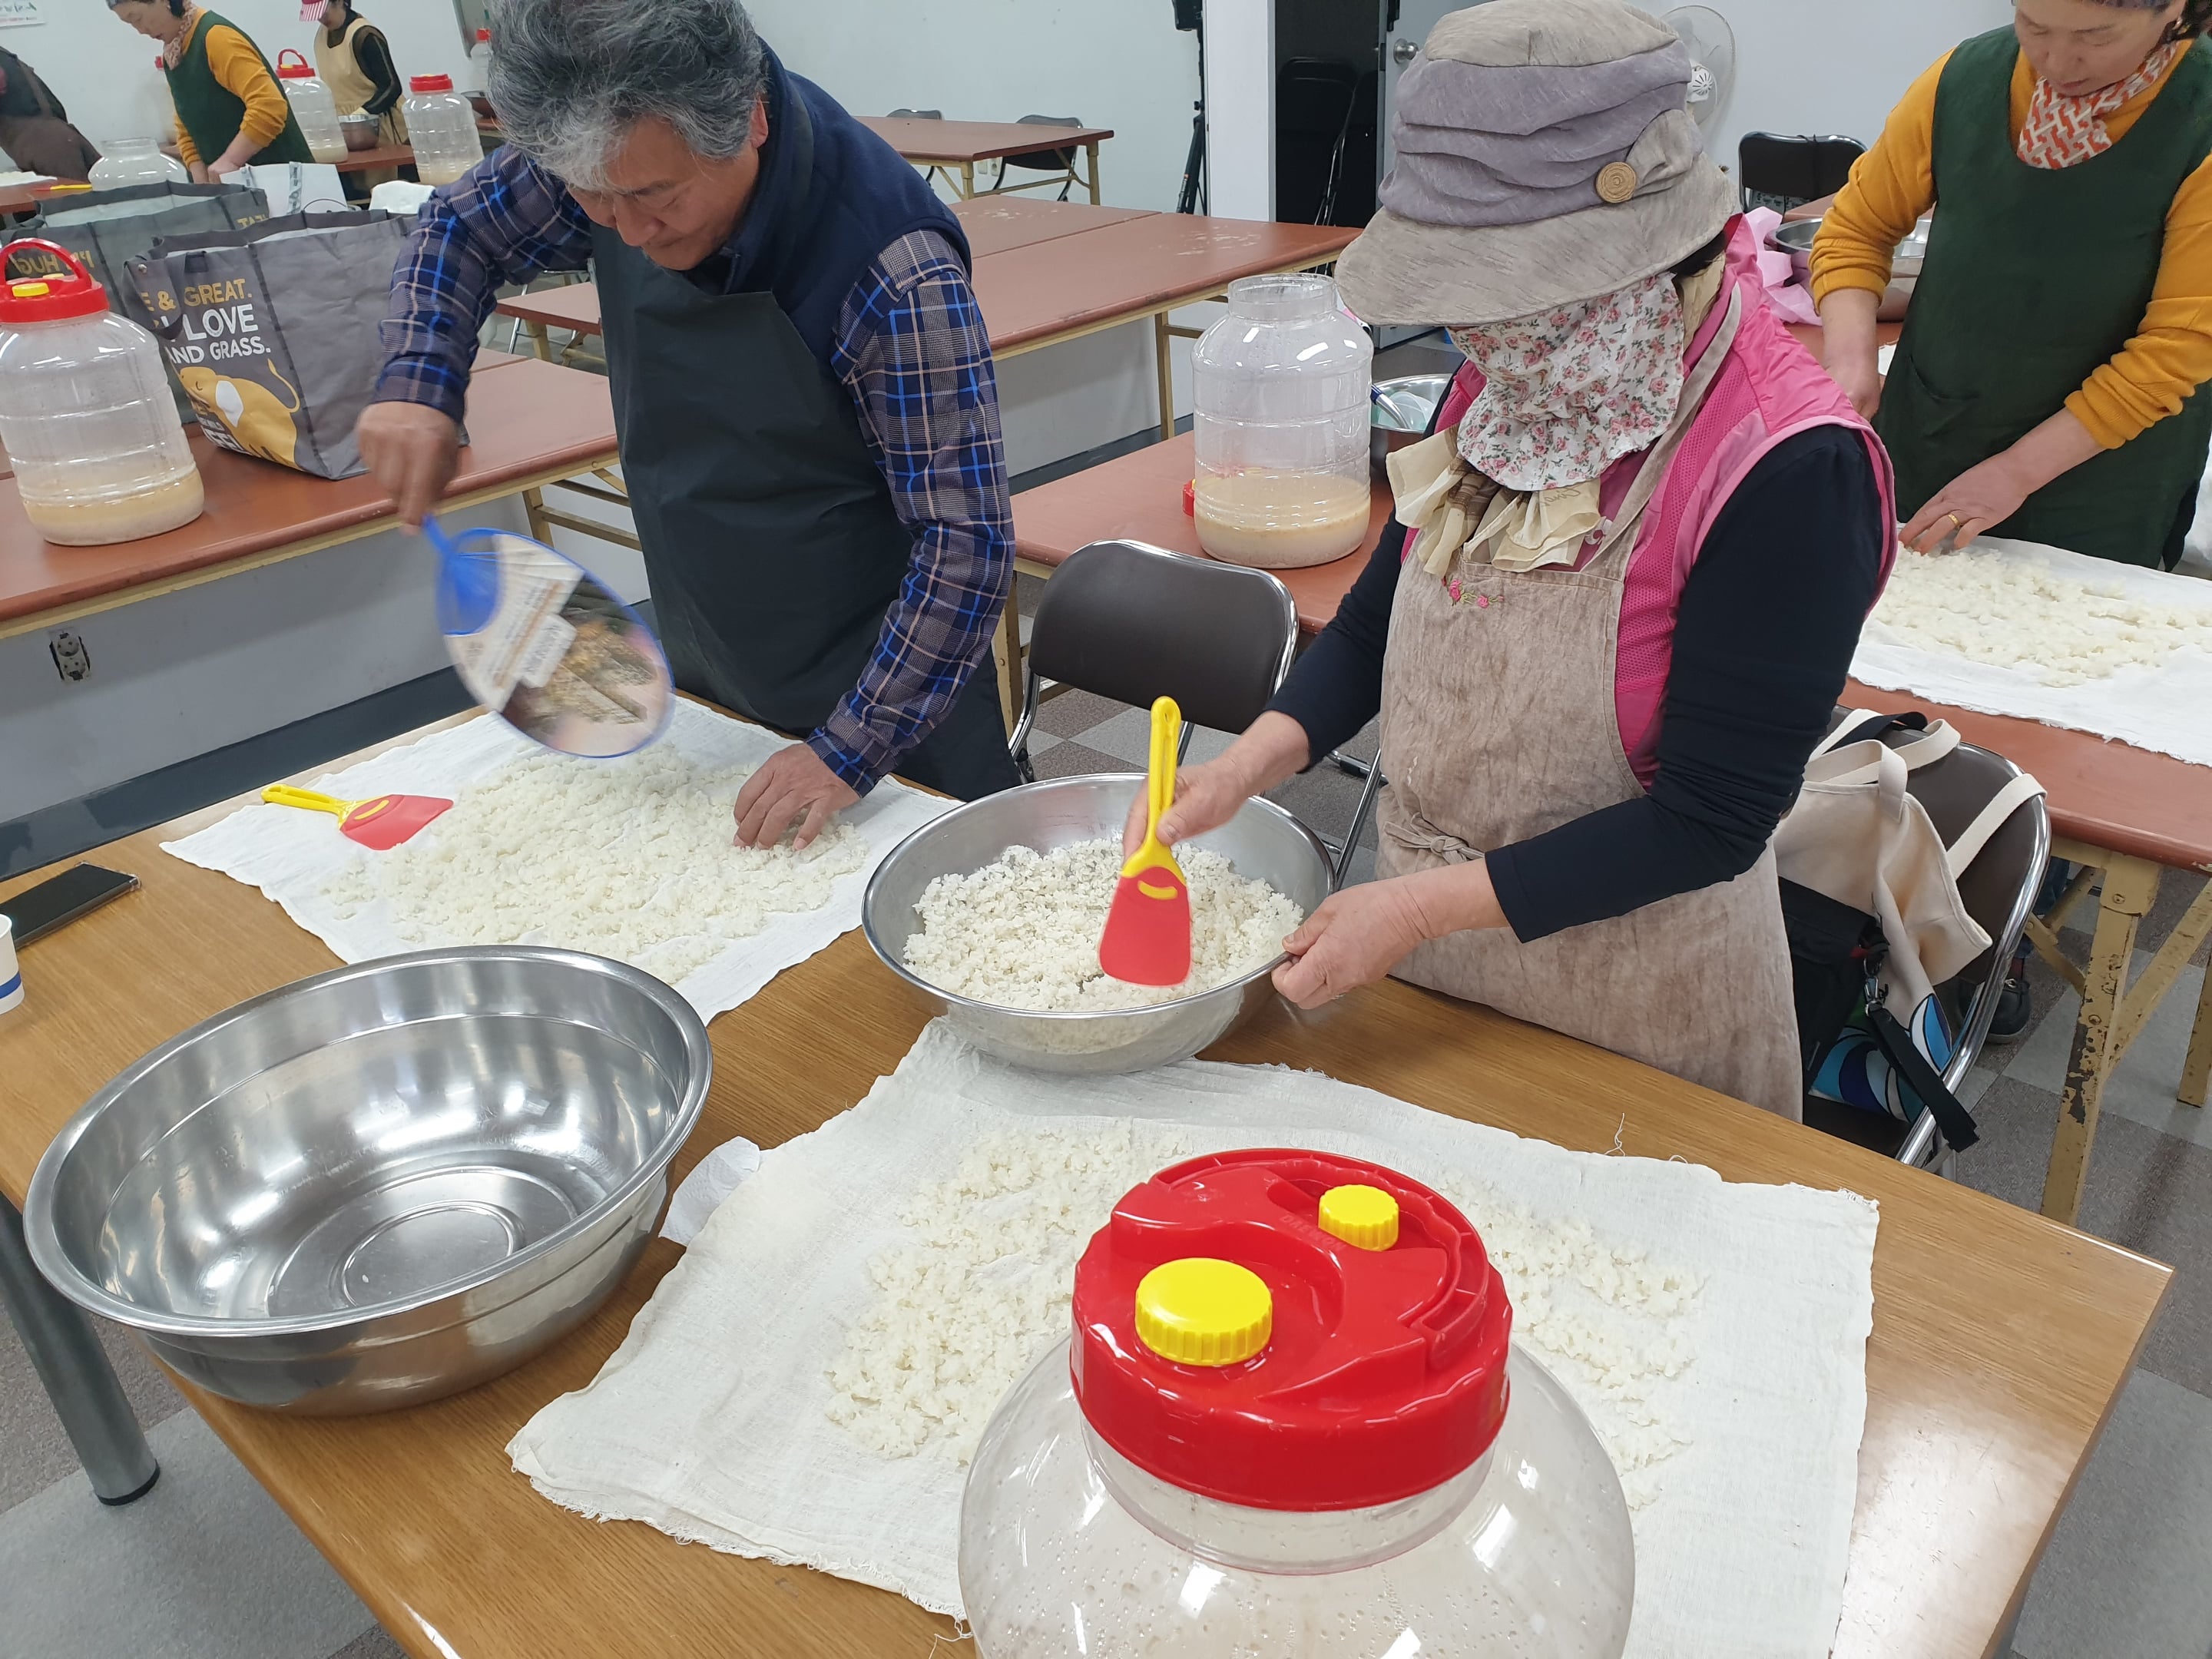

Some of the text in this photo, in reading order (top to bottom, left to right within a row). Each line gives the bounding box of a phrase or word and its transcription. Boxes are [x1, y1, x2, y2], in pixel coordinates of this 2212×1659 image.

[184, 278, 253, 306] GREAT.
[182, 303, 259, 341] LOVE
[209, 336, 271, 361] GRASS.
